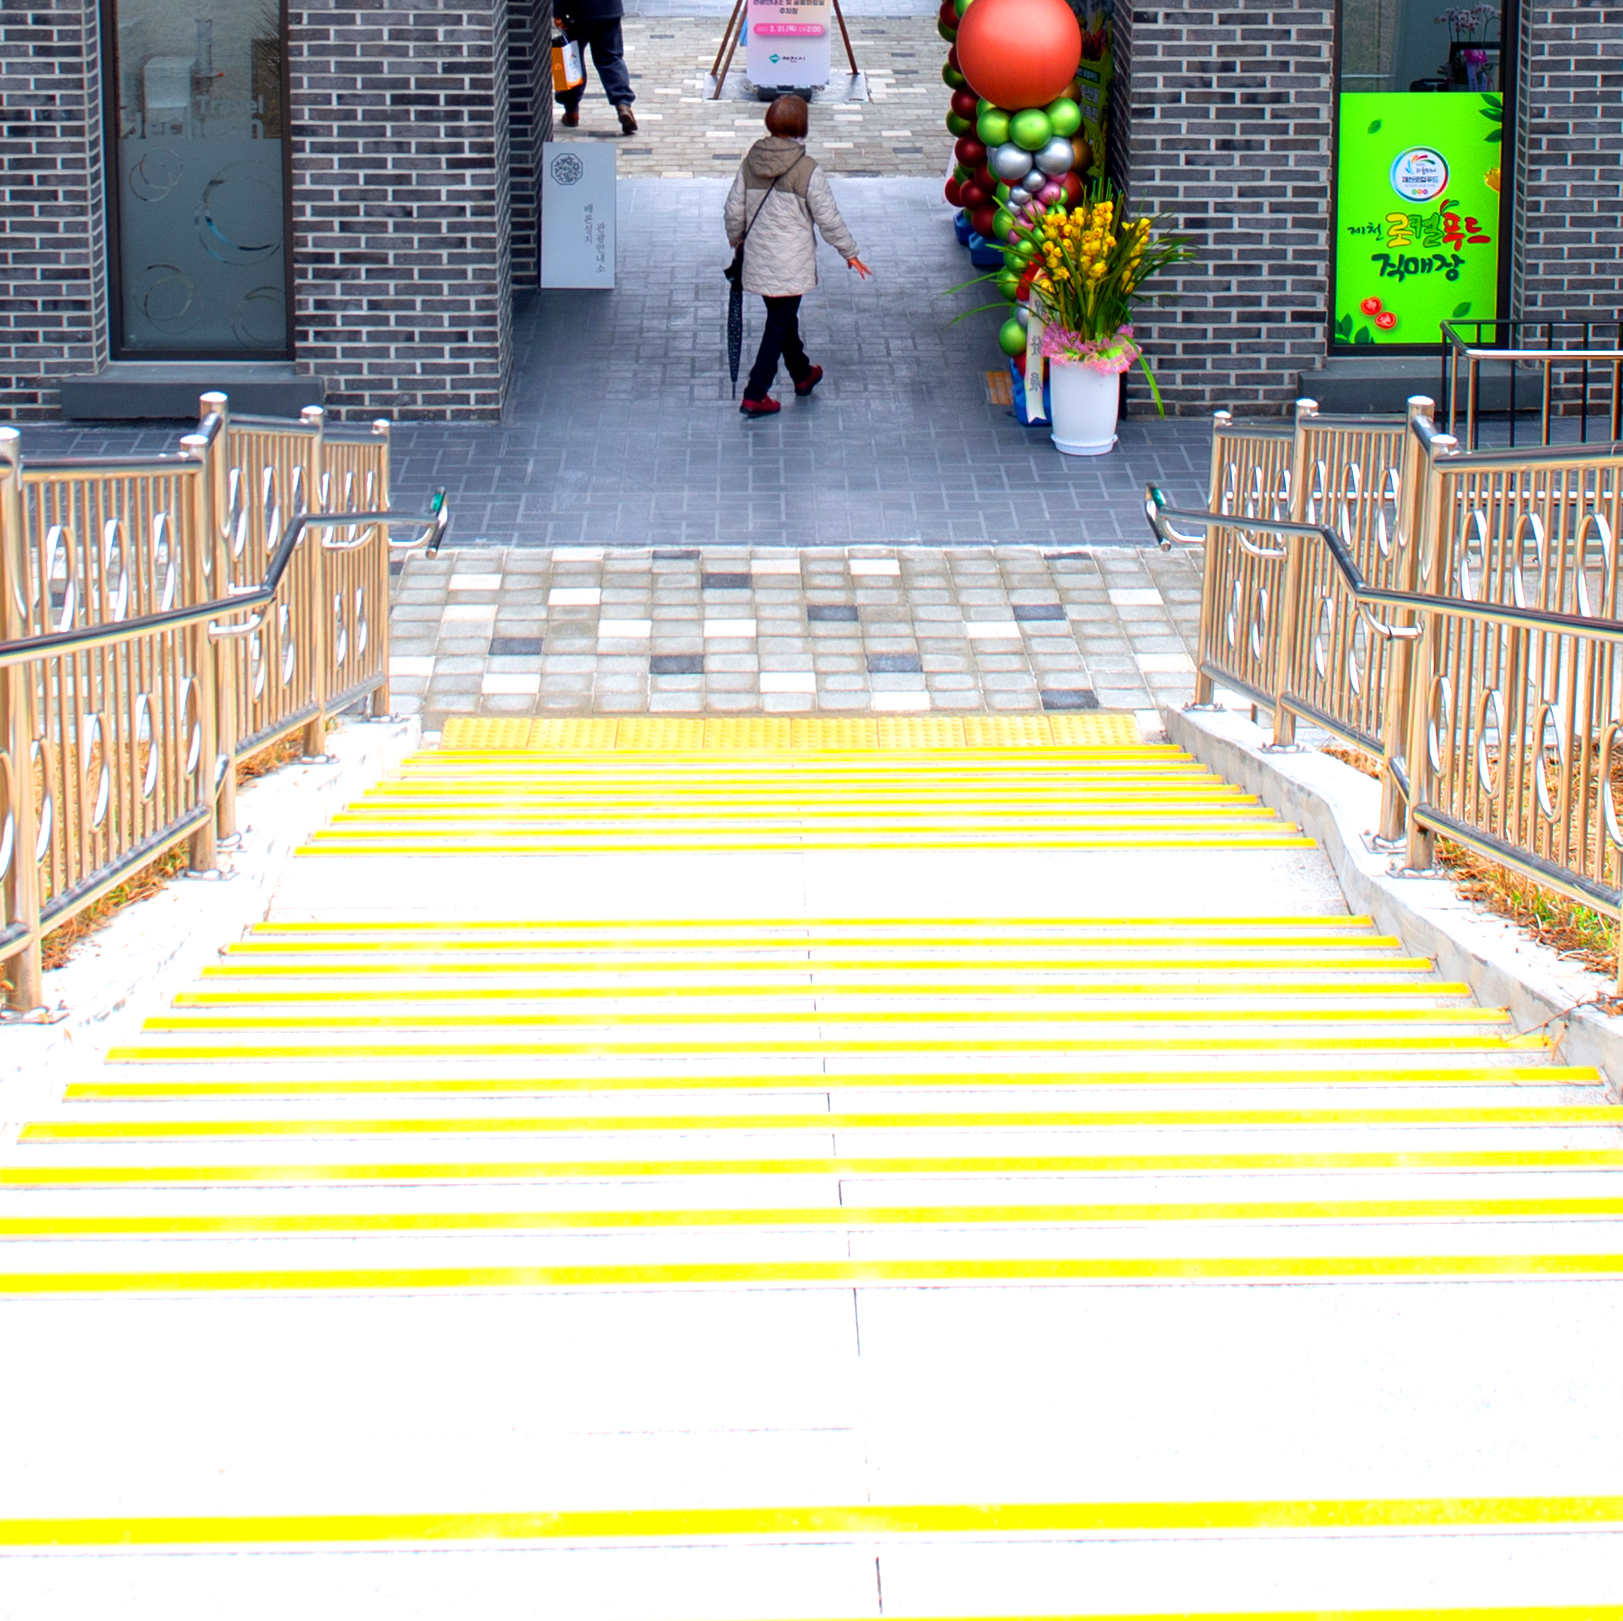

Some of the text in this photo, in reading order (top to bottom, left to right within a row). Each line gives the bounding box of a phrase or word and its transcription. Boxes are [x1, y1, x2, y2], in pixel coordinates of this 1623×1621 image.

[1347, 212, 1492, 252] 제천 로컬푸드
[1371, 253, 1466, 283] 직매장
